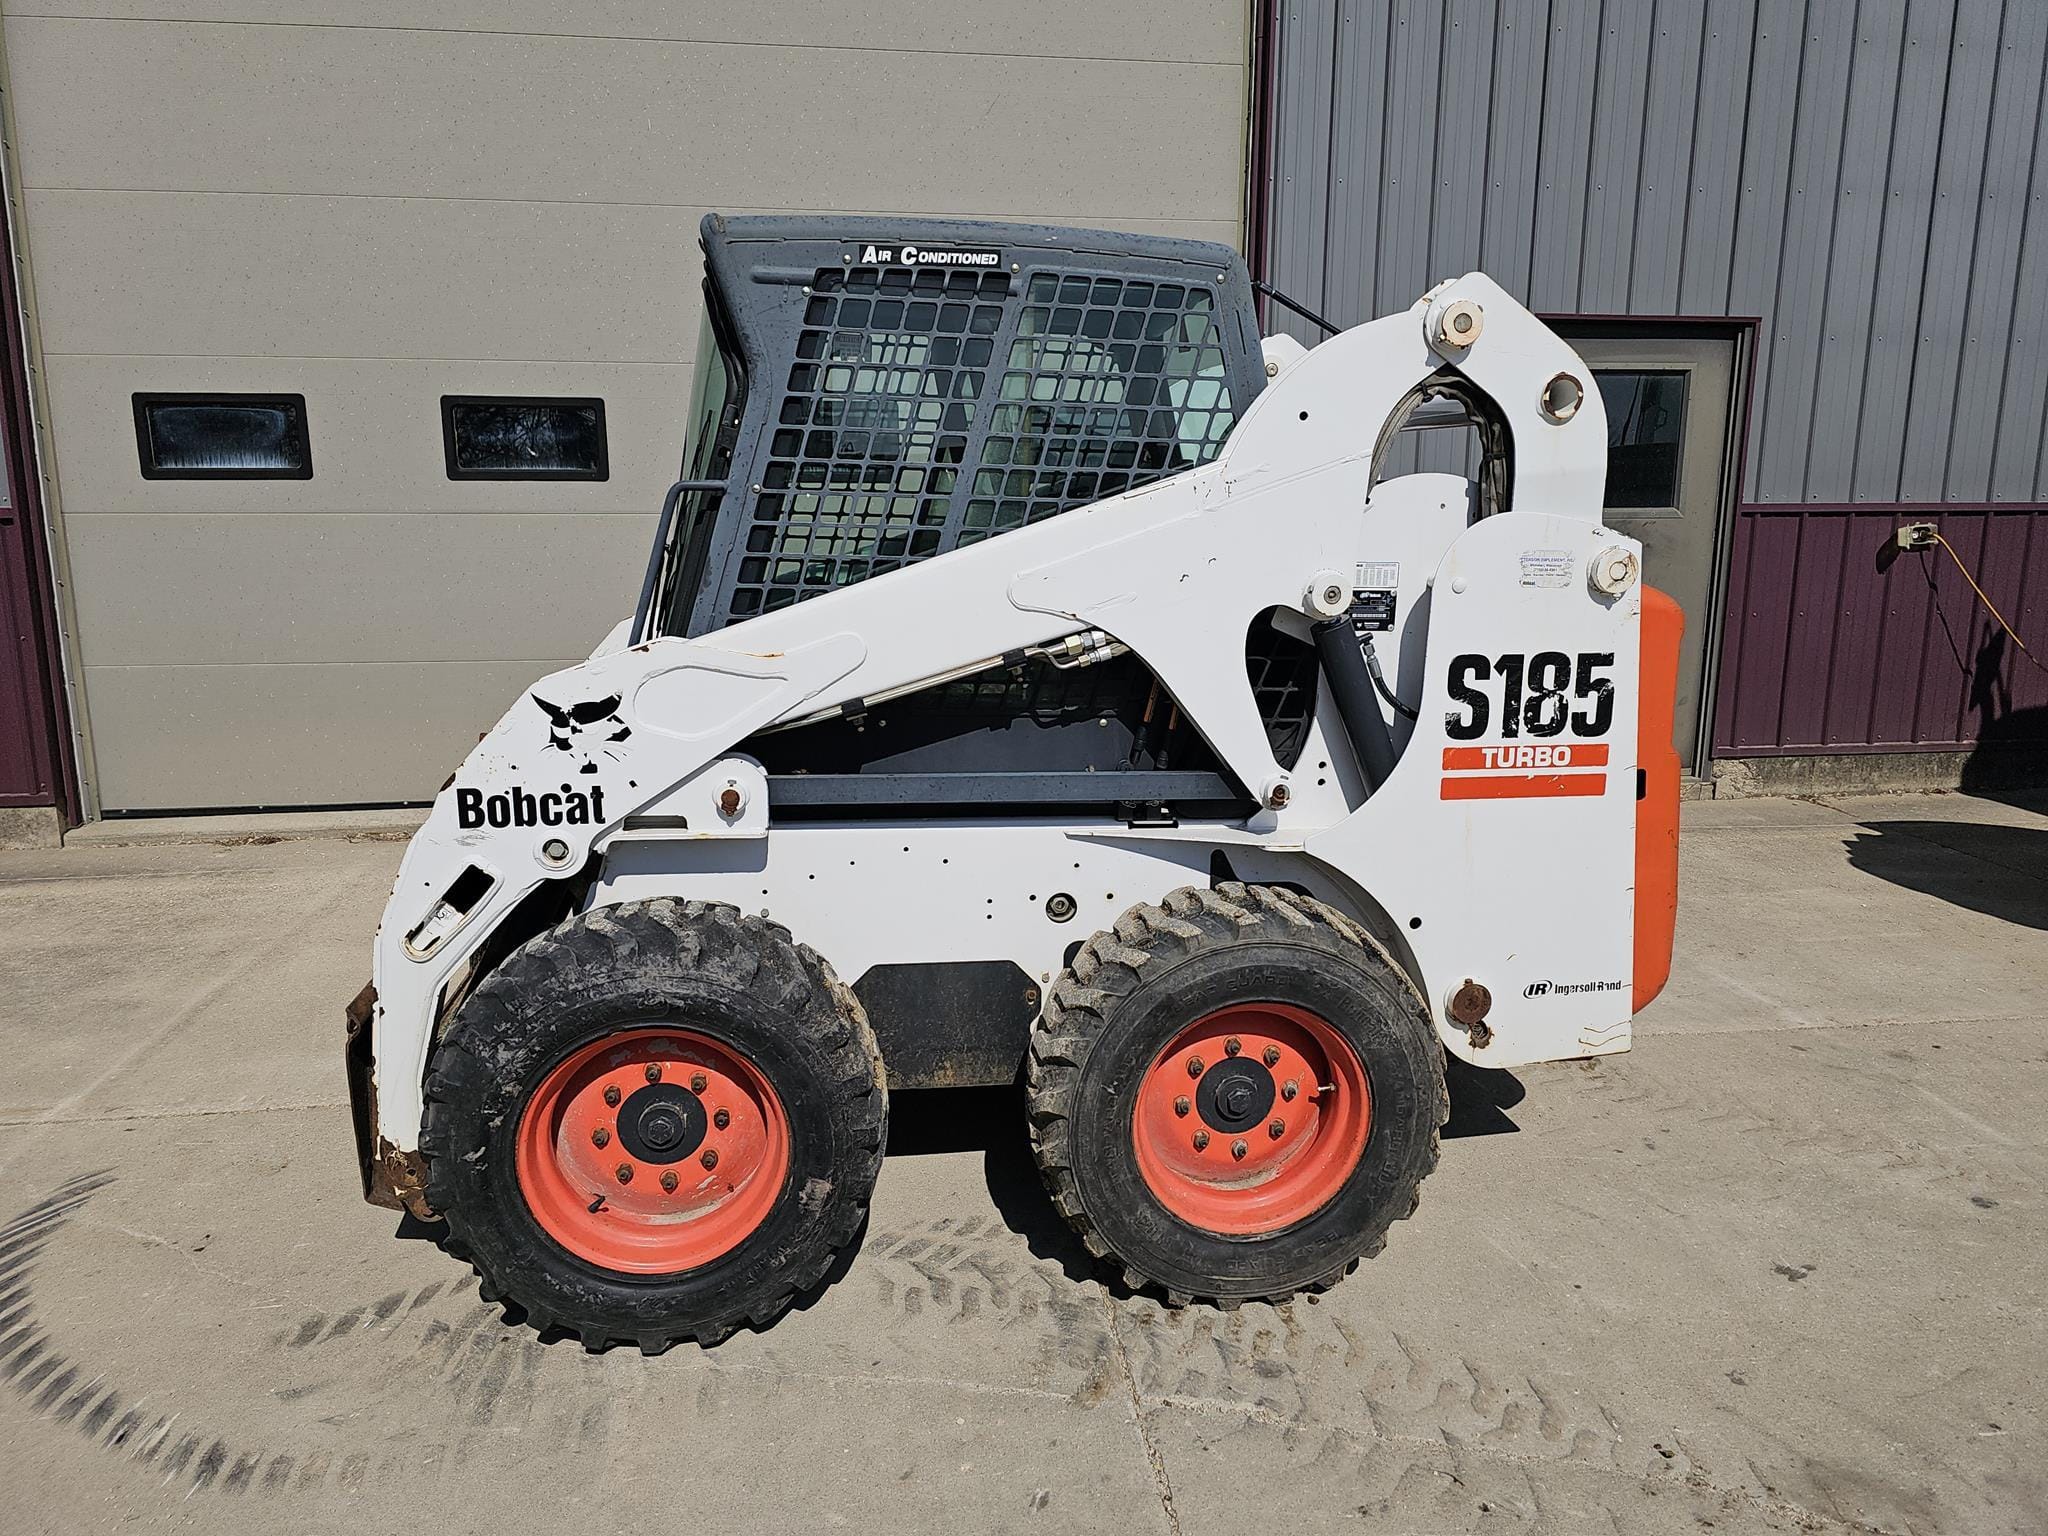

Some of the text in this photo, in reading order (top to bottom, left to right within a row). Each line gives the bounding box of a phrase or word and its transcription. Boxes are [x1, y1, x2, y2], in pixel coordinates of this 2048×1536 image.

[900, 247, 998, 265] CONDITIONED
[1445, 651, 1615, 740] S185
[1481, 746, 1572, 768] TURBO
[456, 785, 606, 829] Bobcat
